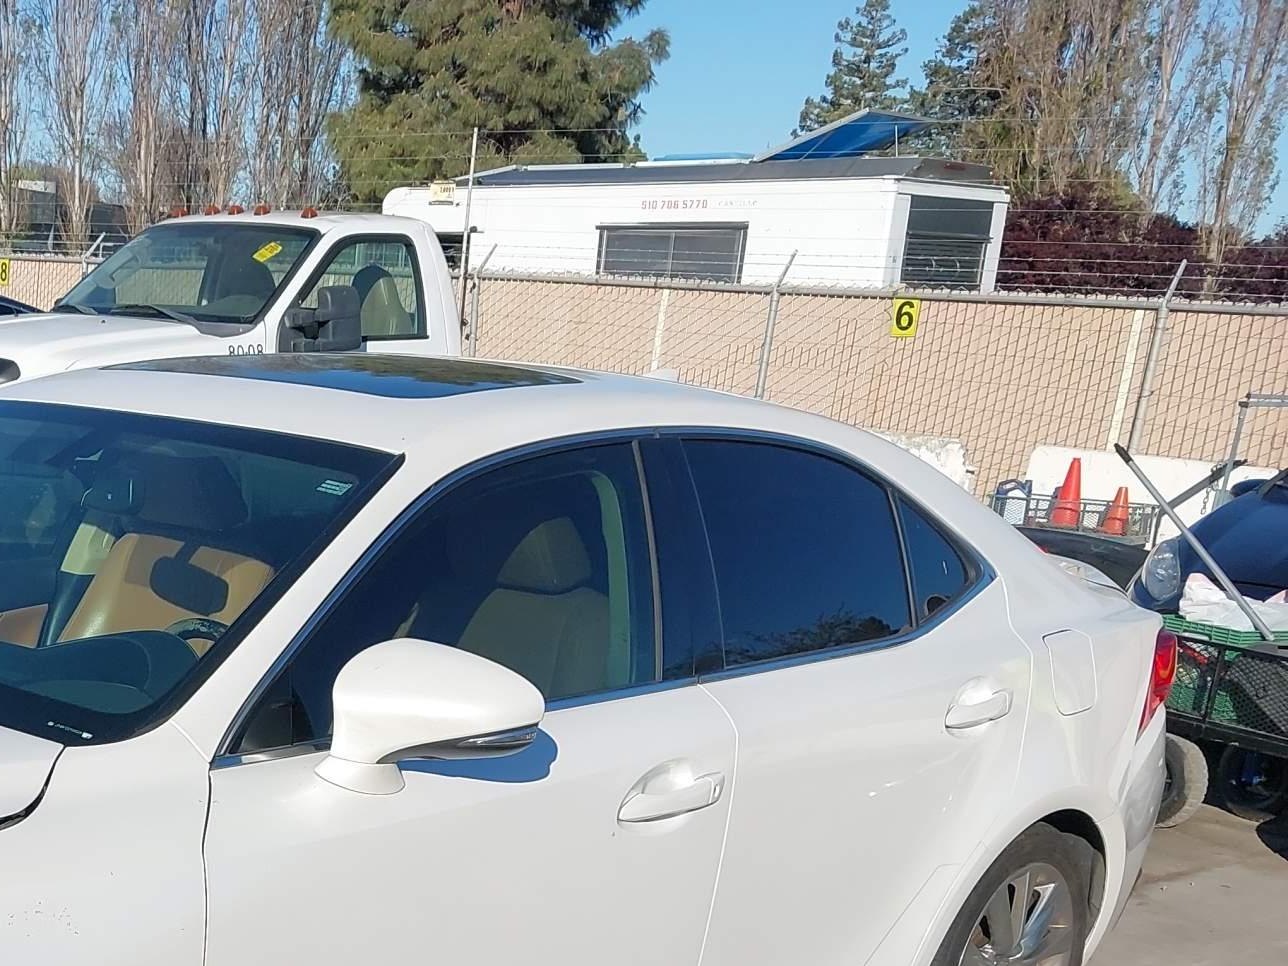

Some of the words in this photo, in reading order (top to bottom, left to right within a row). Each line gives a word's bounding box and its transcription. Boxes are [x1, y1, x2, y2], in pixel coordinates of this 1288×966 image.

[682, 199, 708, 209] 5770
[0, 261, 7, 282] 8
[895, 300, 915, 331] 6
